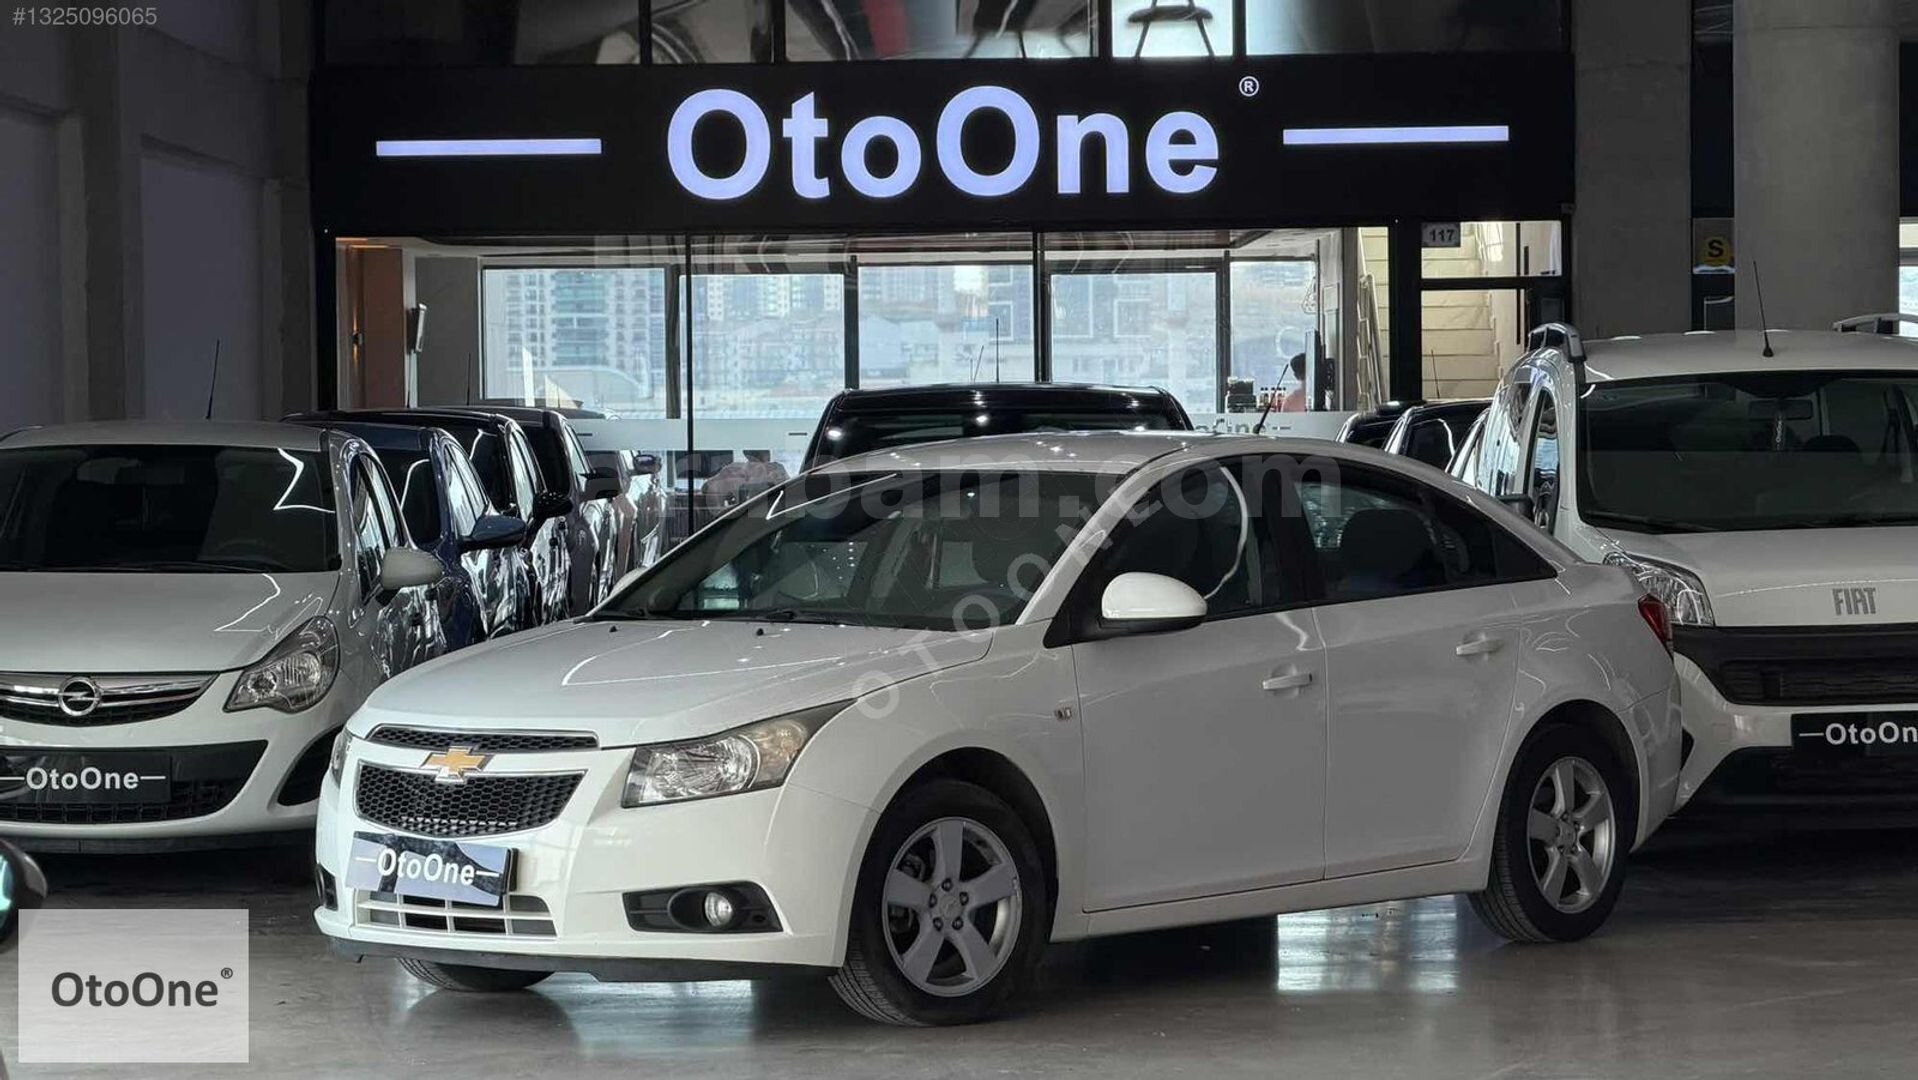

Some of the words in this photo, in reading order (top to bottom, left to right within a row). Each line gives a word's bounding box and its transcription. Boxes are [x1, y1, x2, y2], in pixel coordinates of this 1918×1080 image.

[1429, 229, 1454, 242] 117
[1708, 239, 1725, 258] S
[1832, 587, 1877, 616] FIAT
[26, 766, 140, 790] OtoOne
[377, 847, 475, 886] OtoOne
